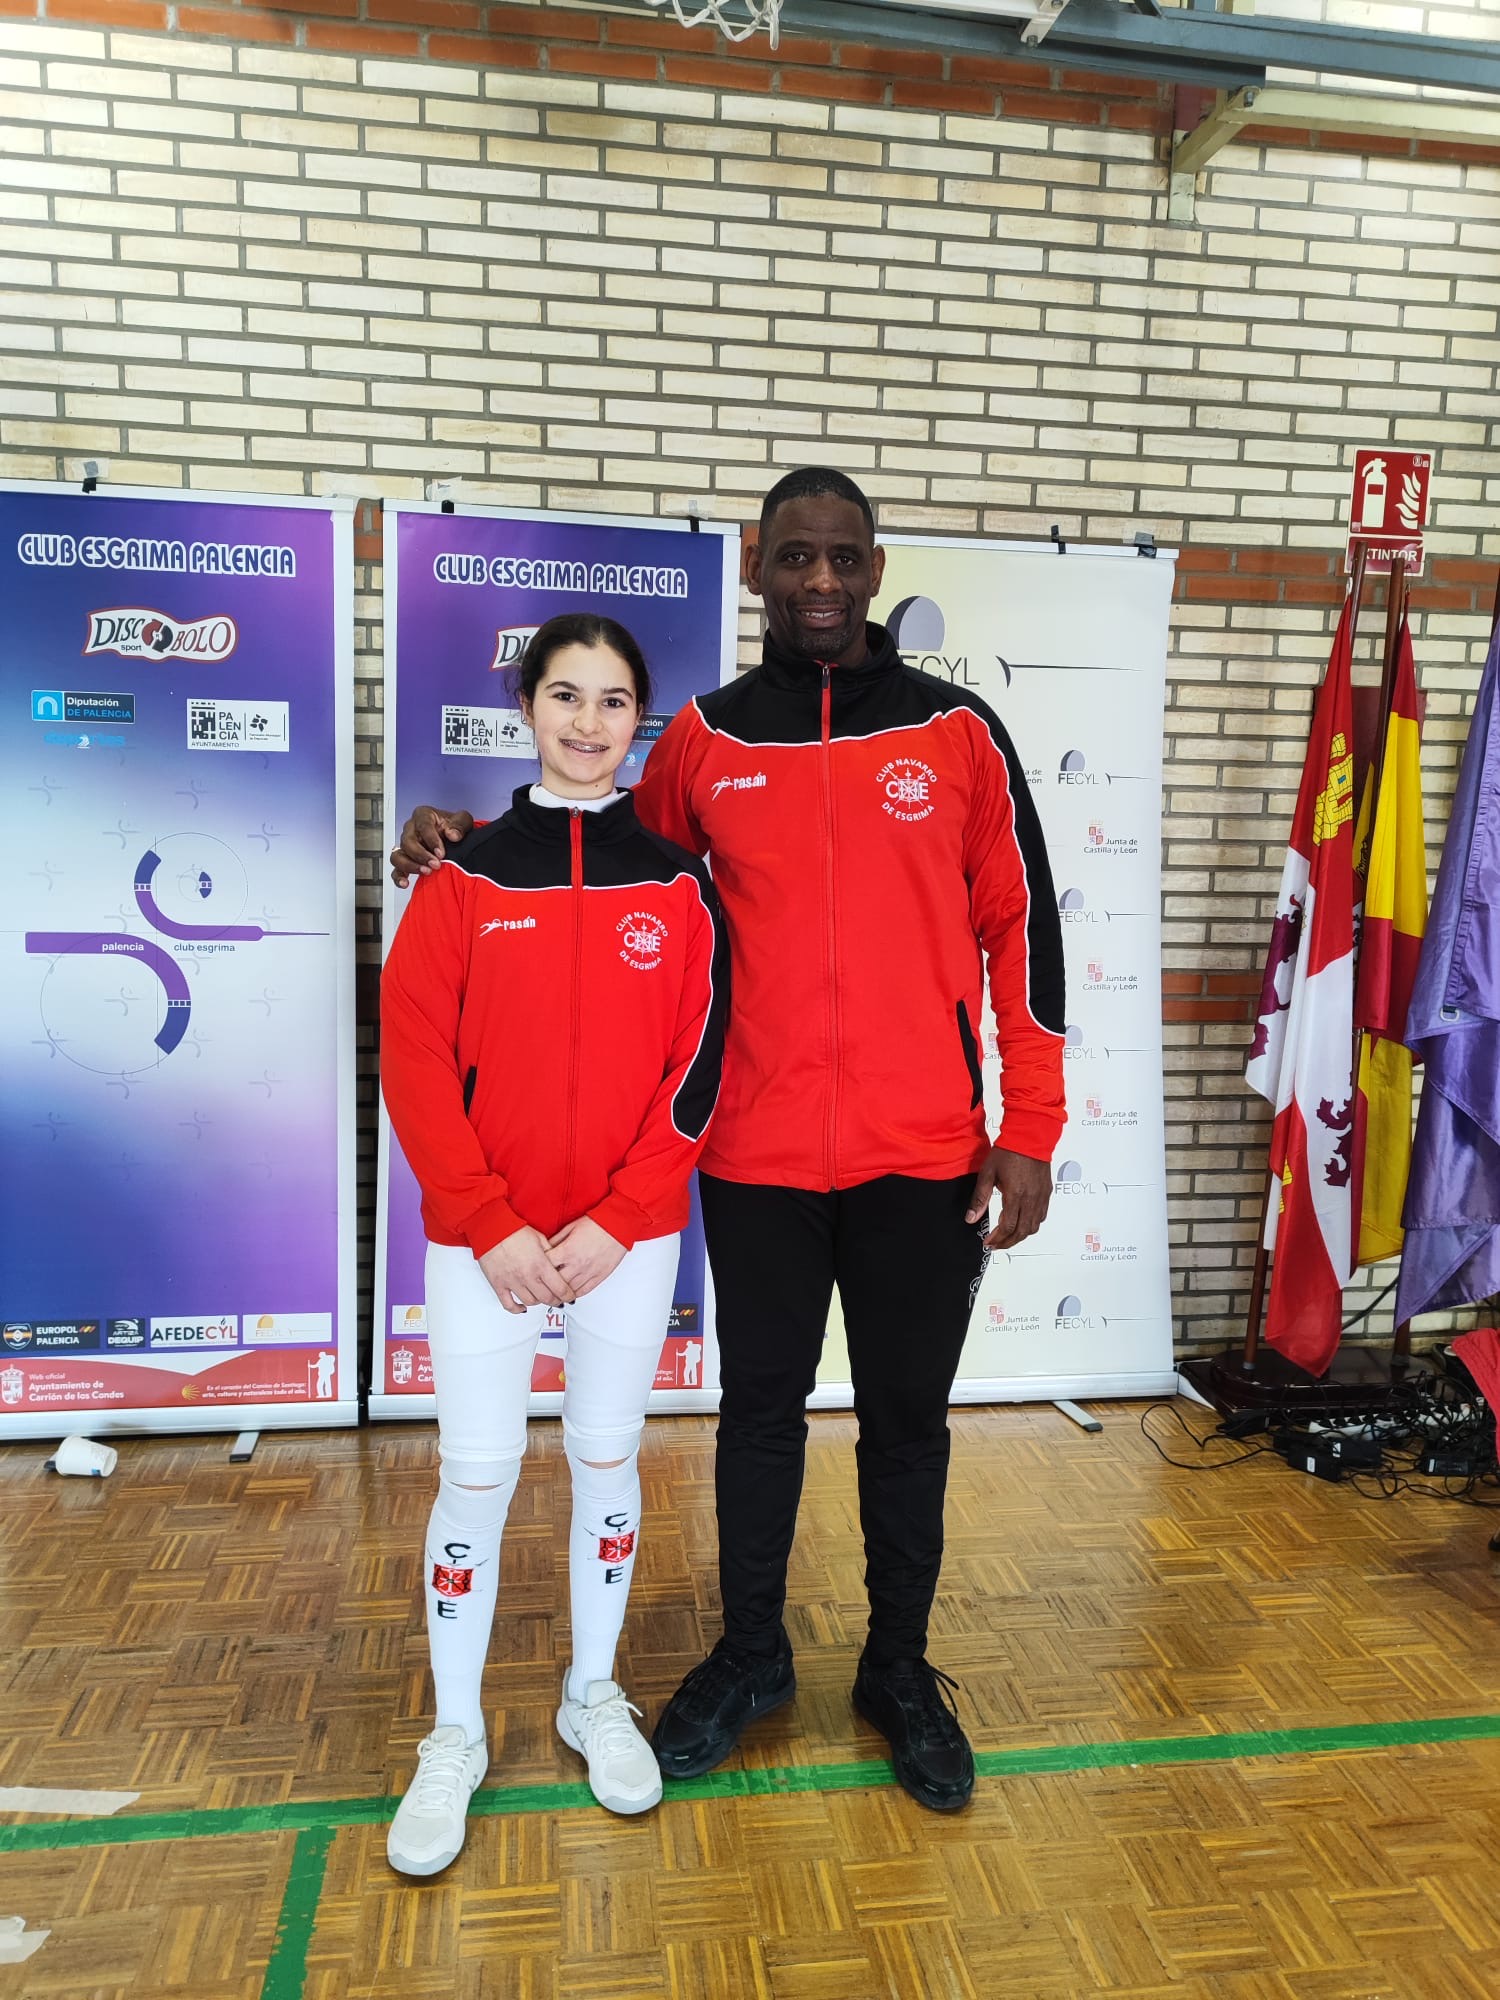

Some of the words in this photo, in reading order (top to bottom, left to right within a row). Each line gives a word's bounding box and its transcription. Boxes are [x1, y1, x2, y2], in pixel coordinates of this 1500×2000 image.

[18, 533, 76, 567] CLUB
[79, 536, 186, 572] ESGRIMA
[189, 542, 296, 577] PALENCIA
[434, 553, 487, 583] CLUB
[489, 558, 587, 592] ESGRIMA
[590, 565, 688, 598] PALENCIA
[121, 644, 142, 652] sport
[66, 697, 119, 707] Diputación
[67, 708, 80, 717] DE
[83, 710, 132, 718] PALENCIA
[218, 712, 234, 720] PA
[218, 722, 242, 730] LEN
[472, 718, 486, 728] PA
[218, 731, 239, 740] CIA
[472, 728, 493, 738] LEN
[471, 737, 490, 746] CIA
[876, 762, 895, 782] CLUB
[895, 758, 937, 782] NAVARRO
[1058, 772, 1100, 784] FECYL
[881, 802, 895, 815] DE
[895, 805, 934, 822] ESGRIMA
[616, 914, 633, 932] CLUB
[634, 912, 668, 936] NAVARRO
[102, 942, 144, 954] palencia
[174, 943, 194, 952] club
[197, 944, 236, 954] esgrima
[620, 950, 630, 962] DE
[630, 957, 662, 970] ESGRIMA
[1064, 1048, 1096, 1058] ECYL
[1055, 1182, 1096, 1194] FECYL
[1055, 1318, 1096, 1330] FECYL
[36, 1326, 78, 1335] EUROPOL
[152, 1326, 238, 1342] AFEDECYL
[36, 1336, 80, 1346] PALENCIA
[108, 1336, 144, 1344] DEQUIP
[28, 1380, 90, 1392] Ayuntamiento
[92, 1380, 104, 1389] de
[28, 1392, 62, 1402] Carrión
[64, 1392, 75, 1400] de
[77, 1392, 90, 1400] los
[92, 1390, 124, 1399] Condes
[604, 1512, 628, 1528] C
[444, 1542, 471, 1559] C
[605, 1566, 624, 1584] E
[437, 1600, 458, 1620] E
